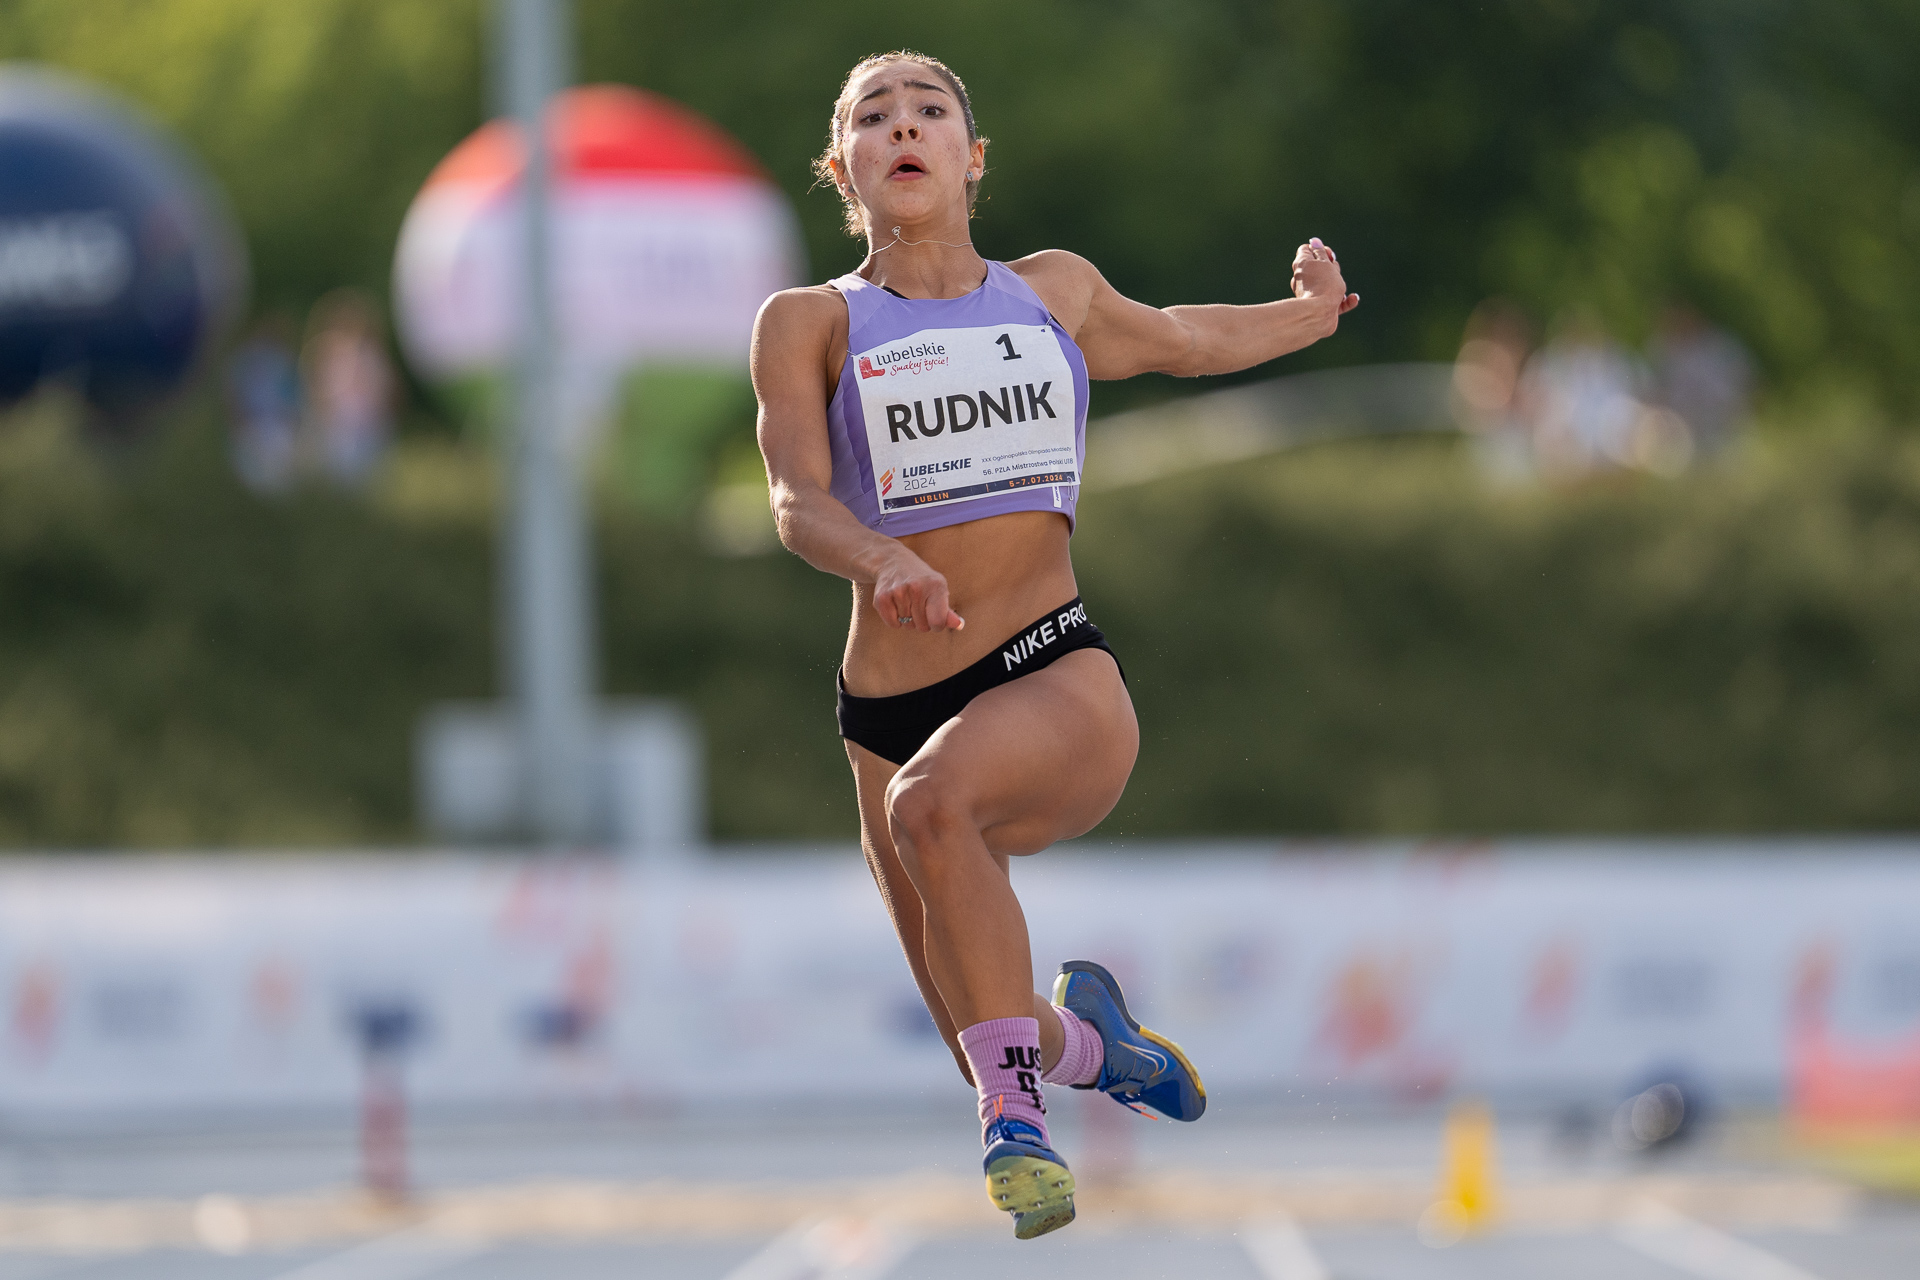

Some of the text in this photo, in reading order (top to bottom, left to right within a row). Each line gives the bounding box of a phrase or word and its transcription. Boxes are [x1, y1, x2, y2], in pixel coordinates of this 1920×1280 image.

[876, 342, 945, 365] lubelskie
[995, 333, 1022, 361] 1
[890, 358, 923, 376] Smakuj
[886, 381, 1057, 443] RUDNIK
[902, 458, 972, 478] LUBELSKIE
[994, 466, 1011, 474] PZLA
[1012, 461, 1048, 471] Mistrzostwa
[904, 477, 936, 491] 2024
[914, 492, 949, 504] LUBLIN
[1002, 602, 1087, 671] NIKE PRO
